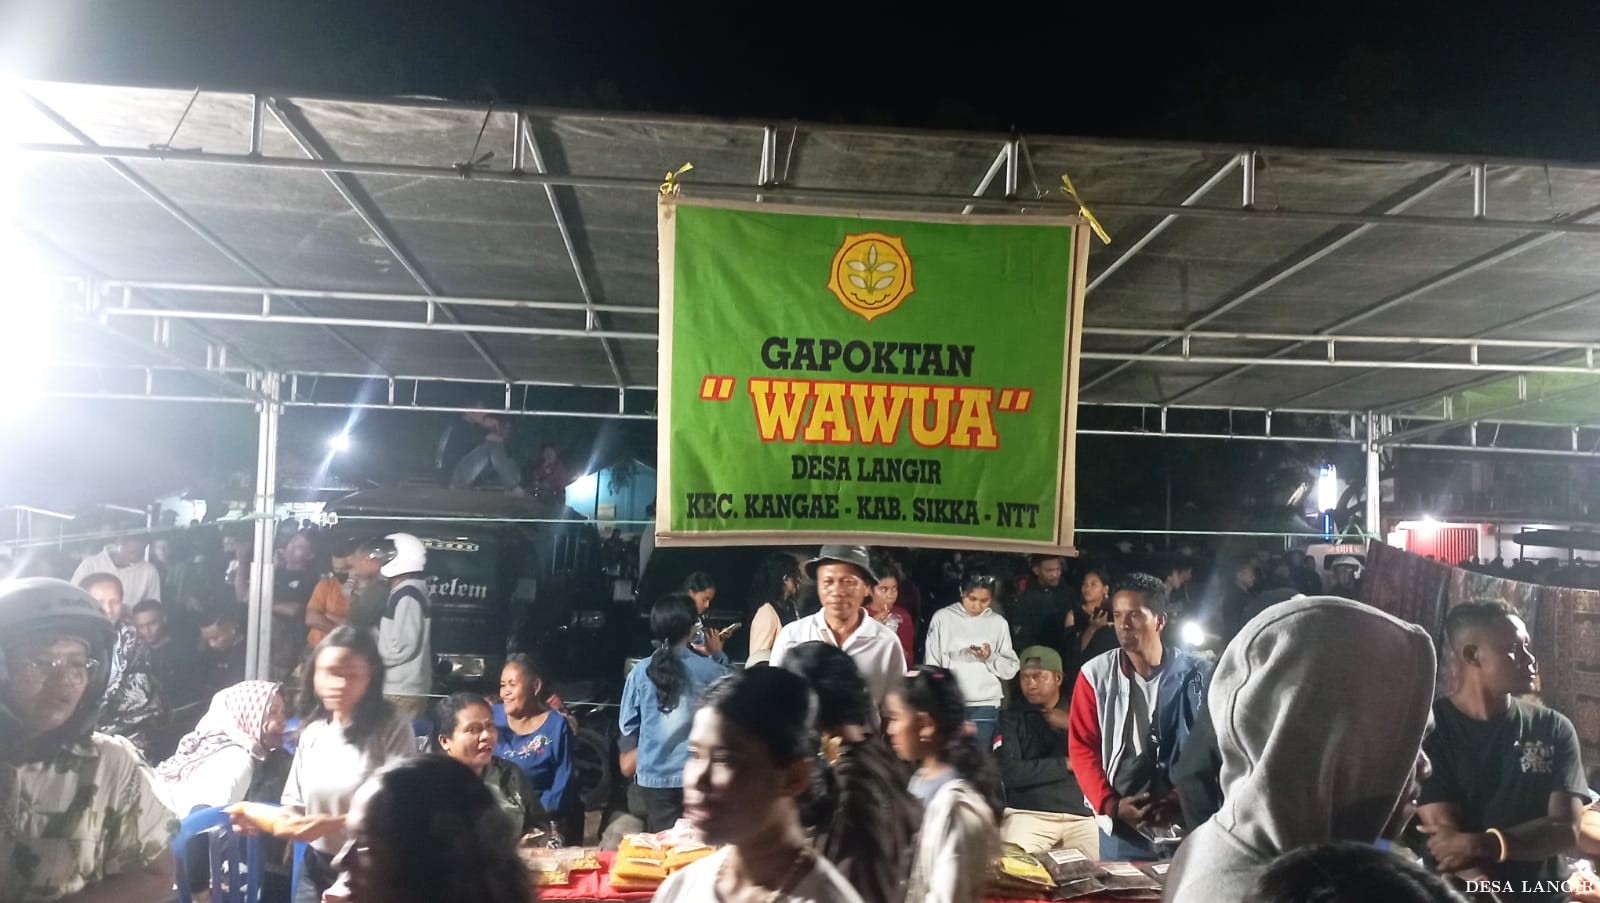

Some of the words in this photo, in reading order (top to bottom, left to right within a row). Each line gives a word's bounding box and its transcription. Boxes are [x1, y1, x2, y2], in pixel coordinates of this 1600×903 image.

[761, 336, 975, 377] GAPOKTAN
[791, 455, 852, 482] DESA
[857, 456, 942, 484] LANGIR
[687, 492, 738, 520] KEC.
[744, 494, 840, 520] KANGAE
[857, 497, 907, 523] KAB.
[913, 499, 980, 525] SIKKA
[997, 502, 1039, 529] NTT
